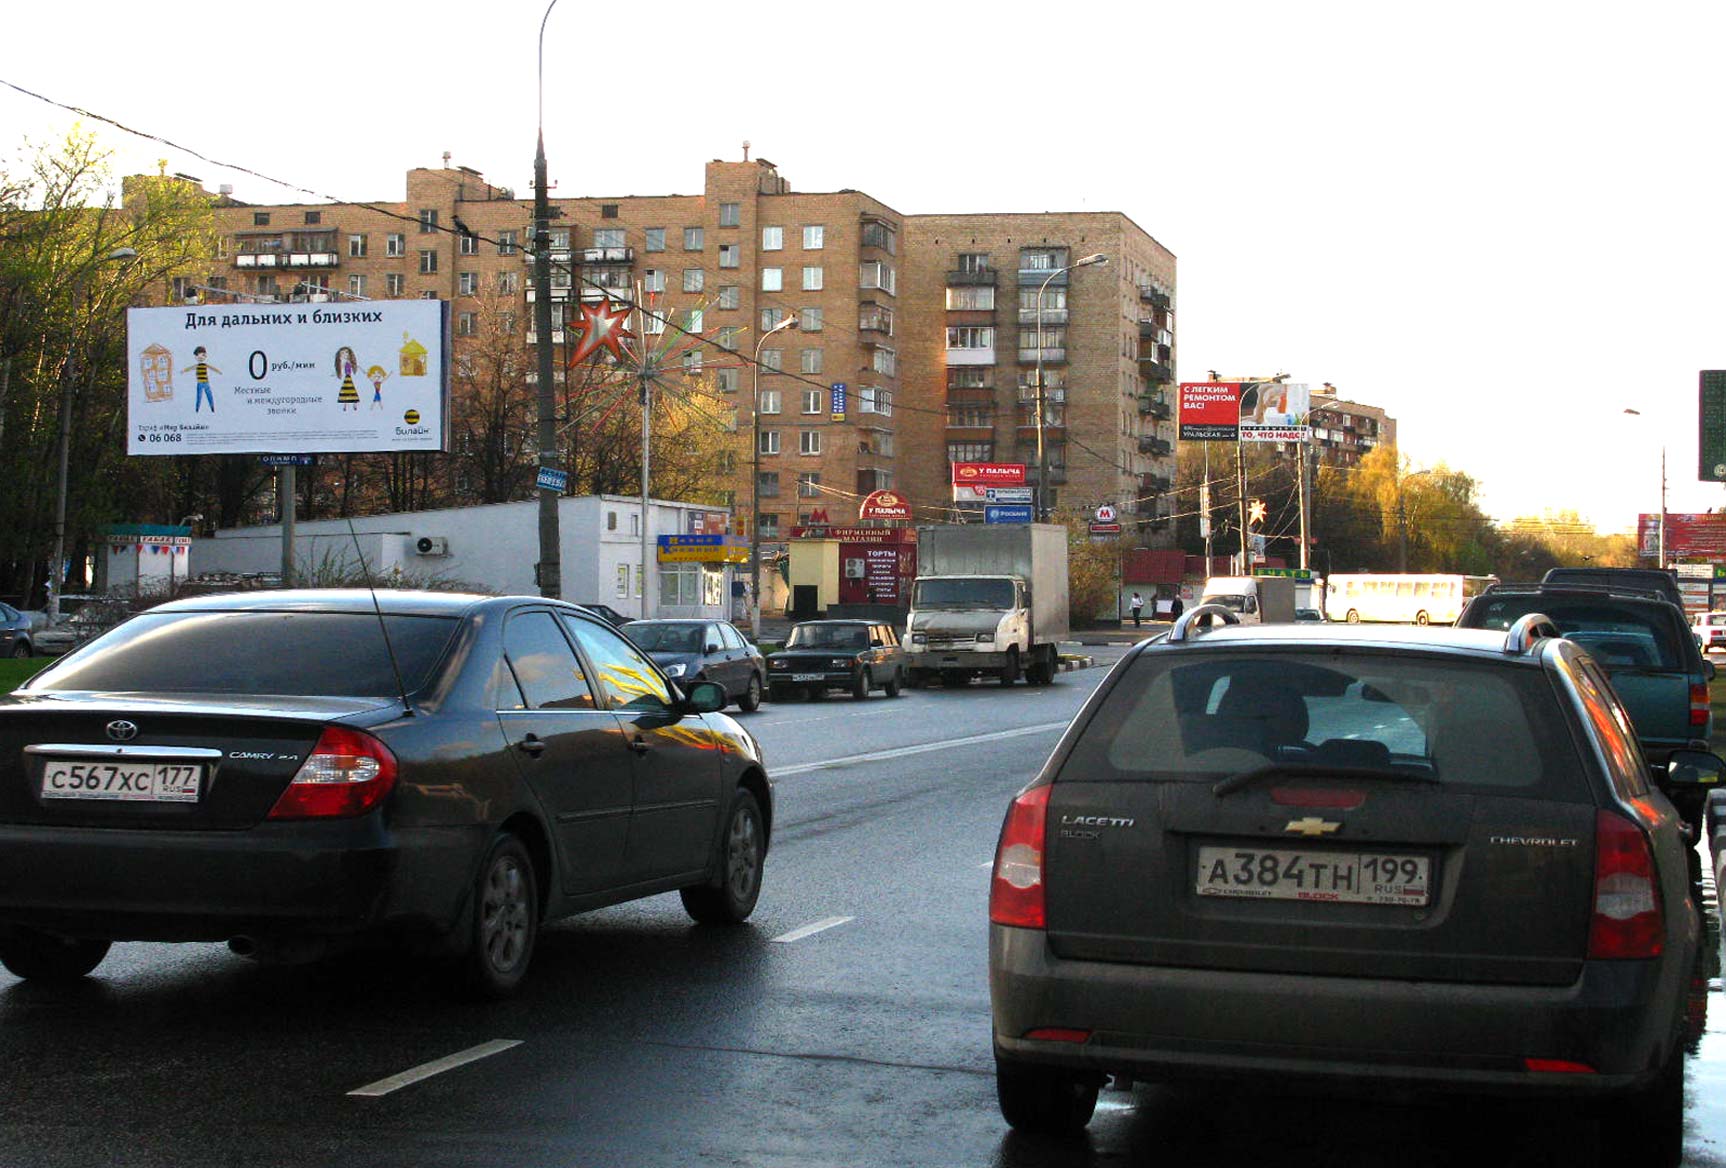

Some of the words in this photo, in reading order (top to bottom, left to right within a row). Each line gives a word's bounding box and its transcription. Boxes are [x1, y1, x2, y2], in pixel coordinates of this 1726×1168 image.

[185, 312, 217, 330] Для
[221, 312, 293, 328] дальних
[297, 313, 308, 324] и
[312, 309, 382, 324] близких
[248, 350, 268, 380] 0
[271, 361, 316, 371] руб./мин
[234, 386, 272, 395] Местные
[149, 433, 161, 443] 06
[164, 433, 182, 442] 068
[1242, 431, 1256, 439] ТО,
[1258, 431, 1274, 439] ЧТО
[875, 507, 906, 515] ПАЛЫЧА
[1257, 569, 1308, 578] ЕЧАТЬ
[229, 752, 274, 761] CAMRY
[51, 765, 149, 791] С567ХС
[158, 767, 194, 785] 177
[163, 785, 182, 793] RUS
[1061, 815, 1135, 827] LACETTI
[1489, 836, 1578, 846] CHEVROLET
[1208, 852, 1353, 891] А384ТН
[1364, 857, 1418, 883] 199
[1374, 884, 1401, 895] RUS
[1298, 891, 1339, 901] BLOCK
